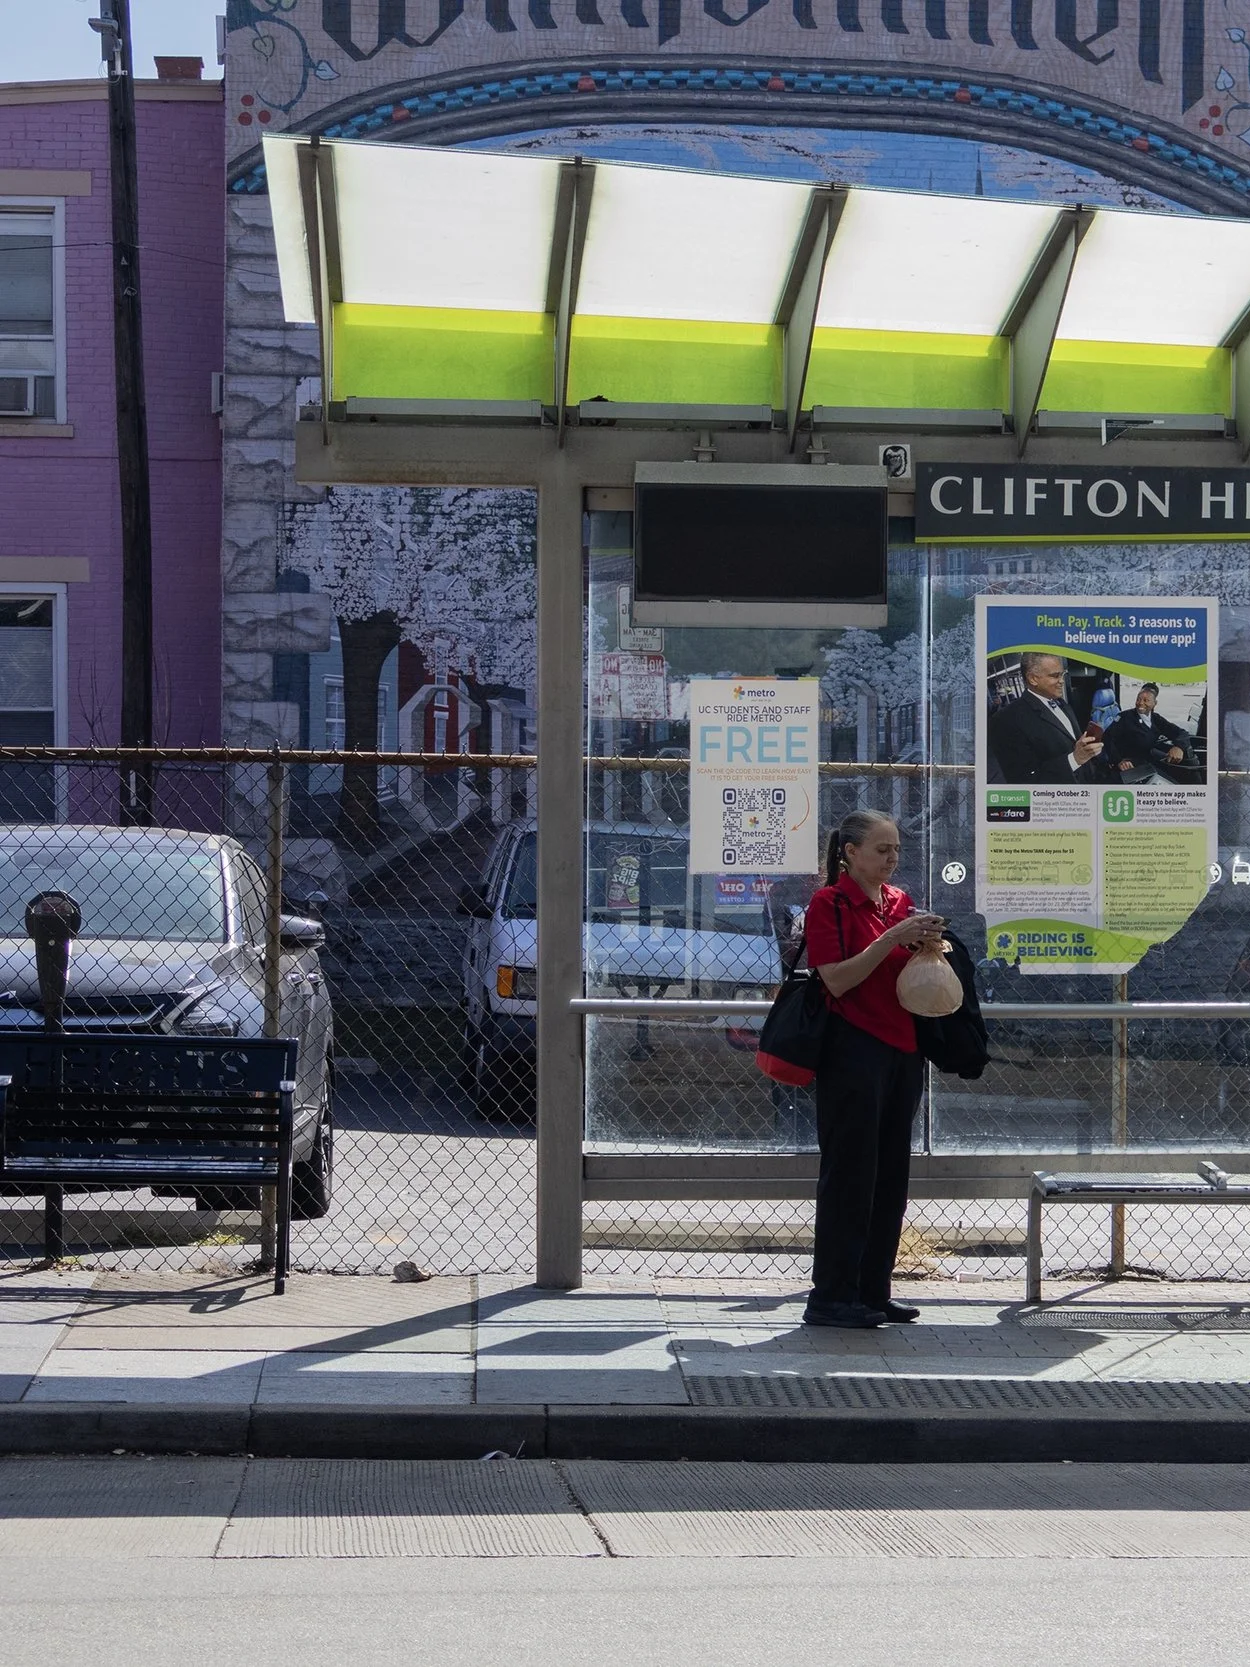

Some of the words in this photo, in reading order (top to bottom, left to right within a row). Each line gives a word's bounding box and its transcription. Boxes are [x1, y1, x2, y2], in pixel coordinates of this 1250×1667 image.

[930, 476, 1171, 518] CLIFTON
[1036, 615, 1065, 627] Plan.
[1068, 616, 1091, 630] Pay.
[1093, 615, 1125, 628] Track.
[1128, 616, 1136, 628] 3
[1139, 618, 1182, 628] reasons
[1184, 617, 1197, 628] to
[1065, 631, 1106, 644] believe
[1108, 632, 1120, 644] in
[1122, 634, 1142, 644] our
[1144, 635, 1168, 645] new
[1170, 633, 1196, 647] app!
[747, 688, 775, 697] metro
[698, 706, 711, 714] UC
[713, 706, 760, 714] STUDENTS
[761, 706, 782, 714] AND
[784, 706, 811, 714] STAFF
[727, 714, 748, 722] RIDE
[750, 714, 783, 723] METRO
[700, 726, 809, 763] FREE
[1033, 790, 1055, 798] Coming
[1017, 933, 1067, 943] RIDING
[1072, 933, 1085, 943] IS
[1017, 946, 1097, 957] BELIEVING.
